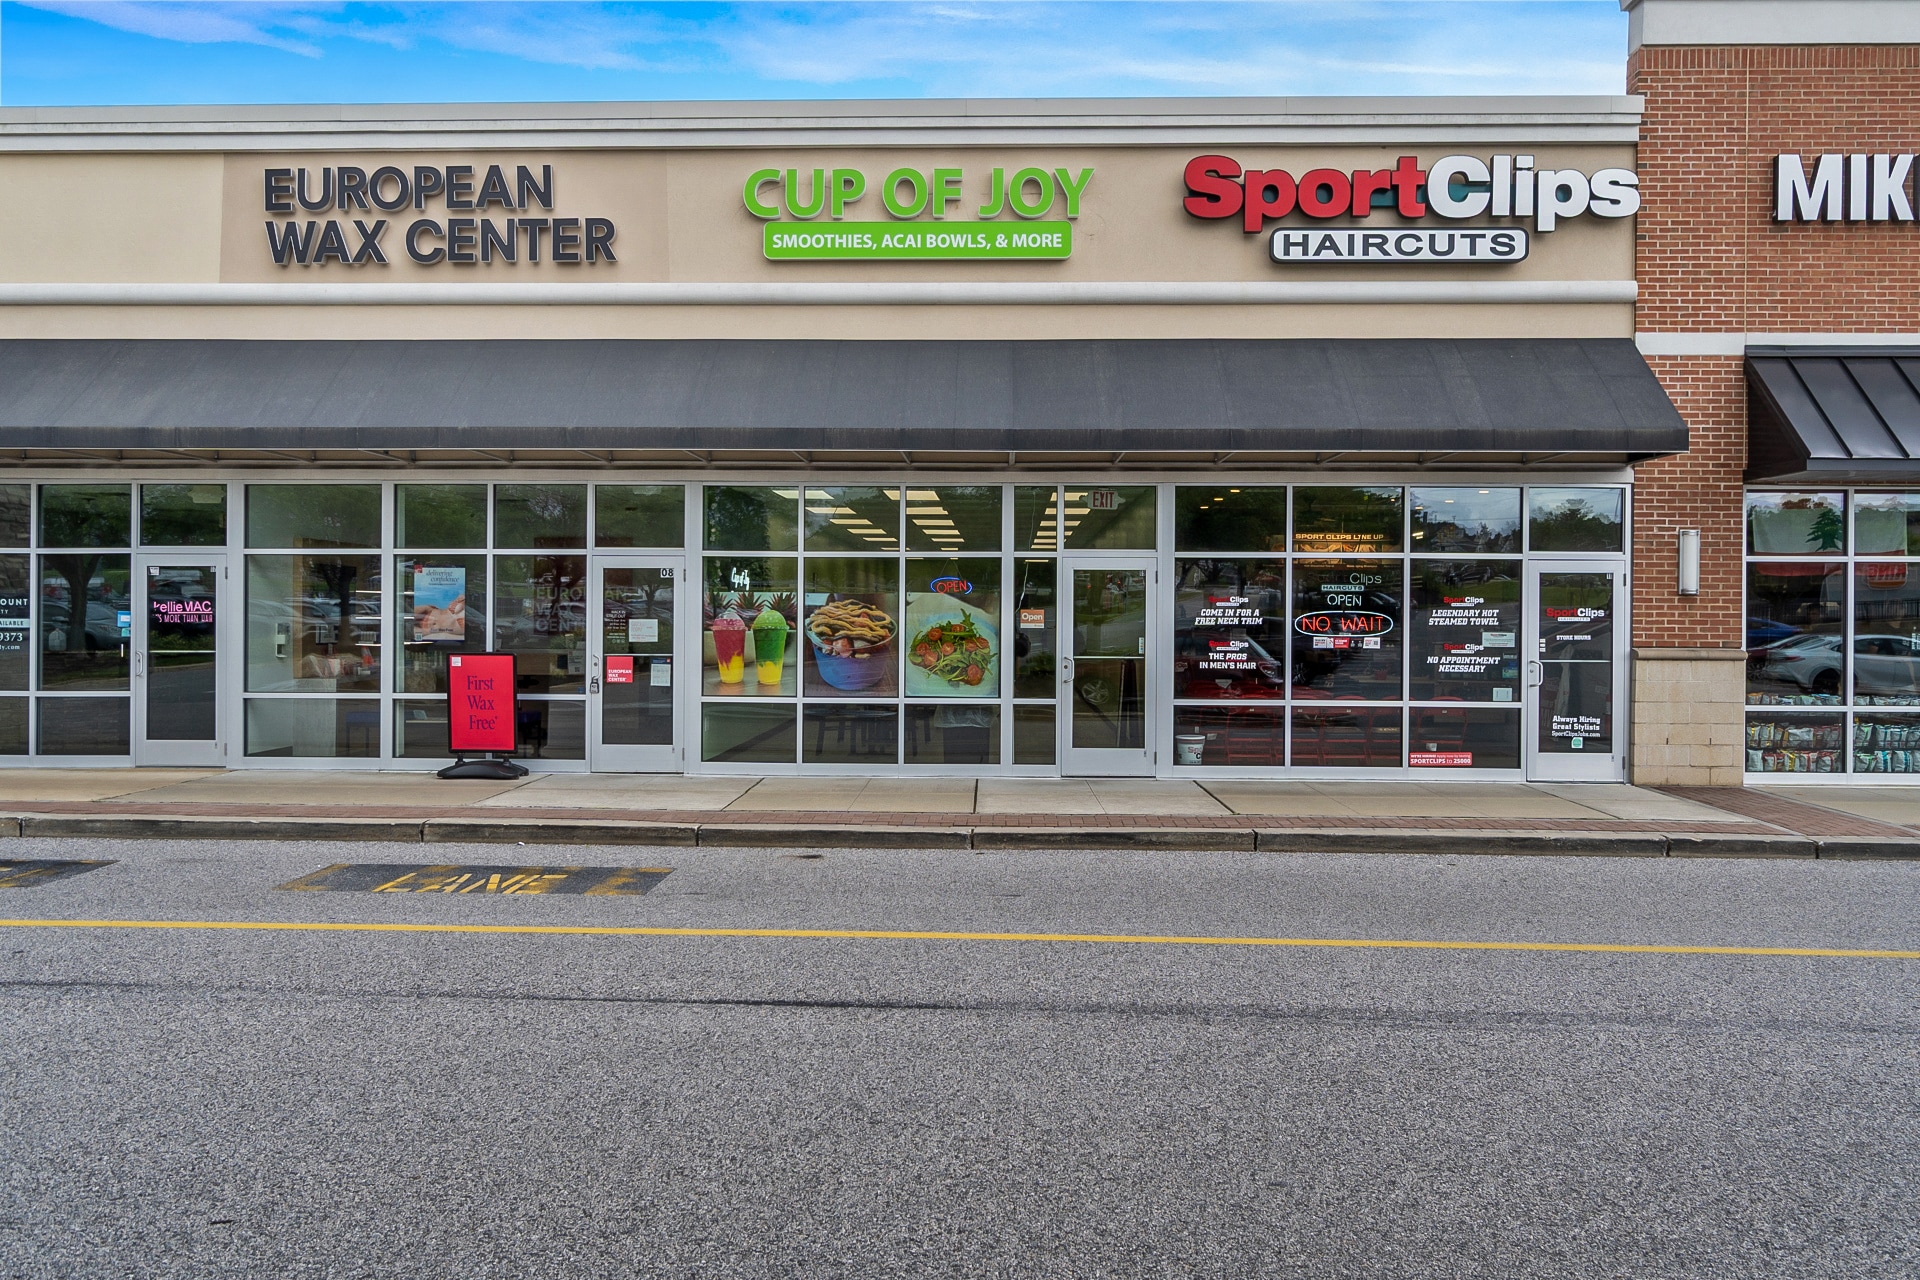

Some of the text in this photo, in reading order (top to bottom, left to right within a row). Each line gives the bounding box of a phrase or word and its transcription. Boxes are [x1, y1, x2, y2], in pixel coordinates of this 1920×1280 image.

[263, 164, 554, 213] EUROPEAN
[743, 167, 1095, 219] CUP OF JOY
[1183, 154, 1641, 234] SportClips
[1772, 153, 1915, 223] MIK
[264, 217, 618, 266] WAX CENTER
[772, 233, 1062, 250] SMOOTHIES, ACAI BOWLS, & MORE
[1282, 233, 1516, 257] HAIRCUTS
[1092, 491, 1115, 508] EXIT
[661, 568, 674, 577] 08
[1349, 572, 1382, 585] Clips
[936, 581, 967, 594] OPEN
[1327, 593, 1362, 606] OPEN
[1021, 613, 1043, 621] Open
[1200, 608, 1260, 616] COME IN FOR A
[1431, 609, 1480, 617] LEGENDARY
[1546, 607, 1605, 619] SportClips
[1194, 617, 1263, 625] FREE NECK TRIM
[1302, 616, 1383, 631] NO WAIT
[1428, 618, 1499, 626] STEAMED TOWEL
[1208, 652, 1225, 660] THE
[1426, 656, 1500, 664] NO APPOINTMENT
[1438, 664, 1486, 673] NECESSARY
[467, 675, 494, 691] First
[467, 695, 495, 710] Wax
[1579, 716, 1601, 724] Hiring
